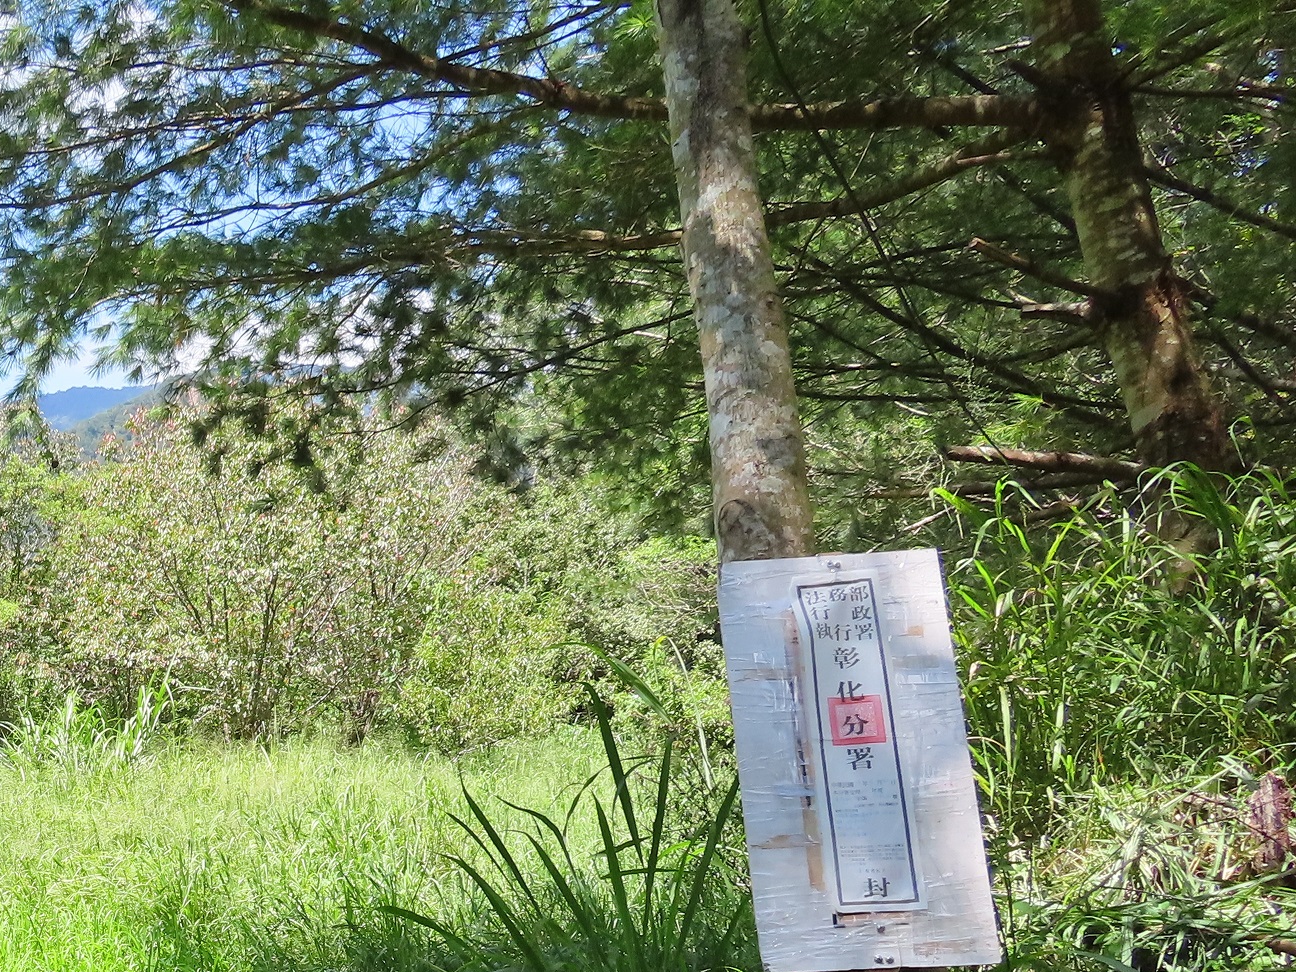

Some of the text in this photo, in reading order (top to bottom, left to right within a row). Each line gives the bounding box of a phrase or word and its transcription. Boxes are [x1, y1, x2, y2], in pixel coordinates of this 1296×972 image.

[805, 586, 869, 605] 法務部
[816, 623, 874, 641] 執行署
[832, 647, 874, 771] 彰化分署
[863, 877, 891, 897] 封
